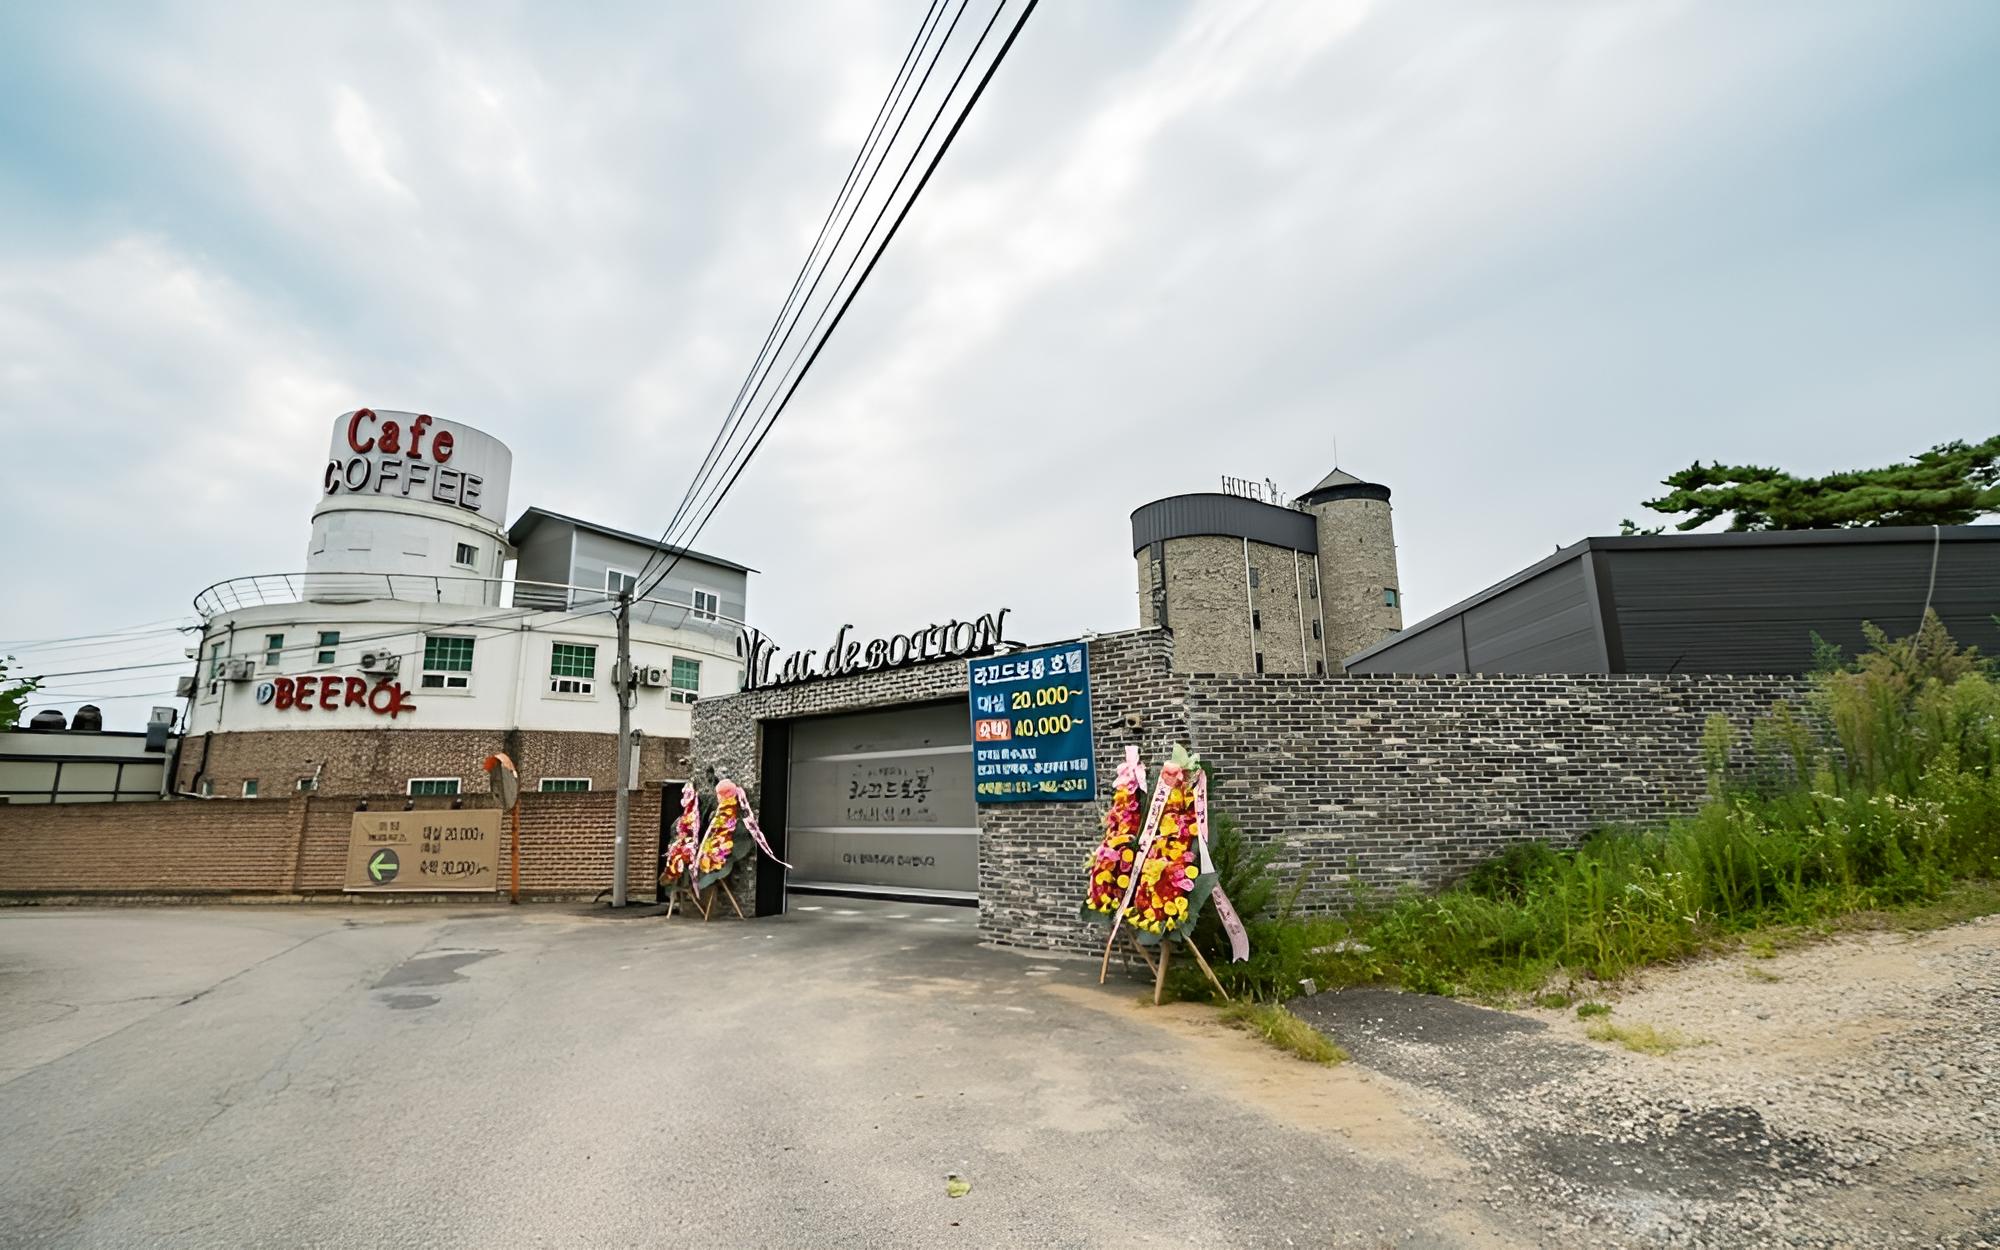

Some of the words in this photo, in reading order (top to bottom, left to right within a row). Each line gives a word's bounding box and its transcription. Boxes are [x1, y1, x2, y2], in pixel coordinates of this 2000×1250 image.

[347, 408, 454, 463] Cafe
[324, 454, 484, 512] COFFEE
[864, 607, 1012, 671] BOTTON
